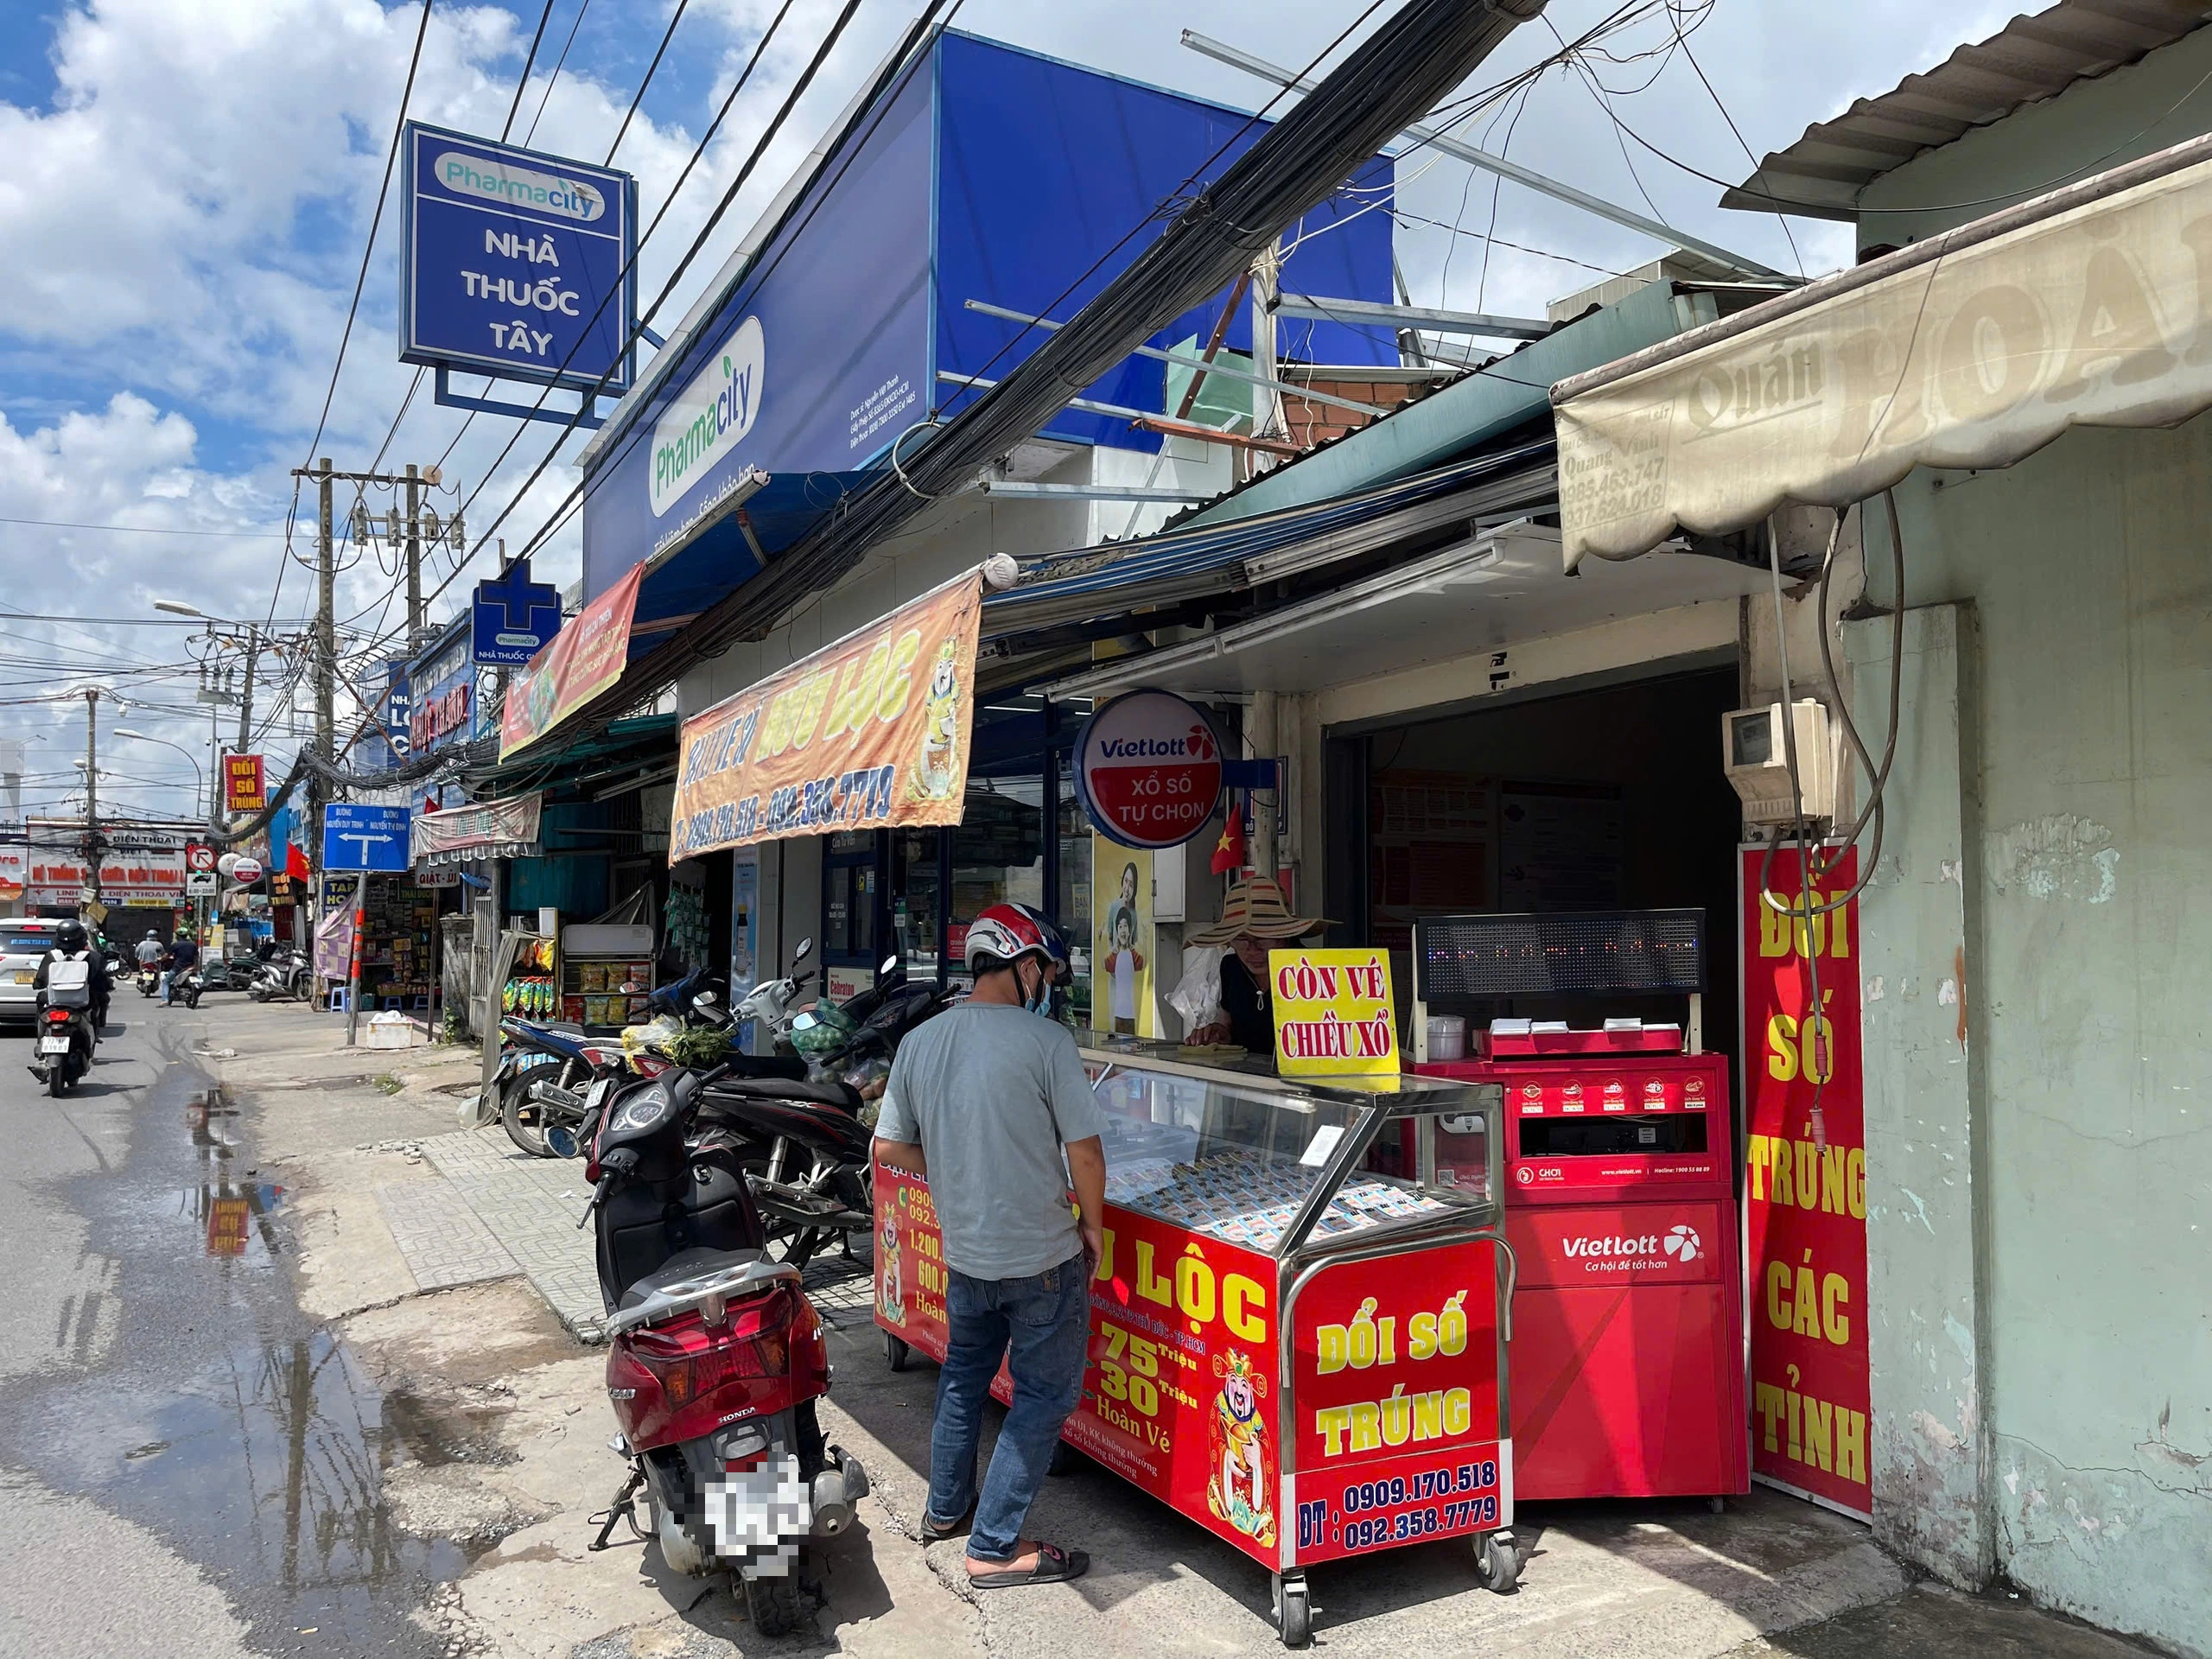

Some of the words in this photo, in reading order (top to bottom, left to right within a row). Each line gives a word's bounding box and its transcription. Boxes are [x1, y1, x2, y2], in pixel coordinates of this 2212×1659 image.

[447, 162, 594, 218] Pharmacity
[486, 229, 559, 267] NHÀ
[461, 270, 580, 316] THUỐC
[489, 320, 553, 356] TÂY
[657, 358, 752, 498] Pharmacity
[479, 649, 497, 659] NHÀ
[498, 650, 524, 660] THUỐC
[499, 636, 537, 645] Pharmacity
[1101, 738, 1185, 758] Vietlott
[236, 777, 256, 794] SỐ
[767, 765, 896, 833] 092.358.7779
[1131, 771, 1160, 796] XỔ
[1166, 770, 1192, 794] SỐ
[1119, 803, 1147, 826] TỰ
[1152, 801, 1205, 825] CHỌN
[1278, 957, 1338, 1000] CÒN
[1345, 956, 1385, 1000] VÉ
[1281, 1010, 1352, 1058] CHIỀU
[1356, 1008, 1391, 1058] XỔ
[1768, 988, 1834, 1085] SỐ
[1746, 1122, 1866, 1220] TRÚNG
[909, 1228, 946, 1265] 1.200.
[1562, 1235, 1658, 1258] Vietlott
[1585, 1261, 1599, 1272] Cơ
[1600, 1260, 1617, 1274] hội
[1618, 1259, 1631, 1271] để
[1632, 1258, 1647, 1270] tốt
[1648, 1260, 1668, 1269] hơn
[916, 1290, 947, 1325] Hoàn
[1135, 1242, 1266, 1344] LỘC
[1767, 1248, 1849, 1345] CÁC
[1102, 1321, 1159, 1378] 75
[1159, 1341, 1198, 1372] Triệu
[1316, 1296, 1395, 1375] ĐỔI
[1409, 1290, 1467, 1360] SỐ
[1101, 1360, 1159, 1417] 30
[1159, 1377, 1198, 1410] Triệu
[718, 1406, 756, 1424] HONDA
[1096, 1394, 1141, 1439] Hoàn
[1146, 1421, 1171, 1453] Vé
[1316, 1383, 1471, 1457] TRÚNG
[1756, 1363, 1866, 1484] TỈNH
[1084, 1438, 1107, 1460] không
[1109, 1453, 1137, 1478] thưởng
[1090, 1427, 1101, 1440] KK
[1102, 1432, 1126, 1459] không
[1128, 1451, 1158, 1477] thưởng
[1344, 1461, 1497, 1513] 0909.170.518
[1299, 1499, 1326, 1548] ĐT
[1344, 1497, 1497, 1550] 092.358.7779
